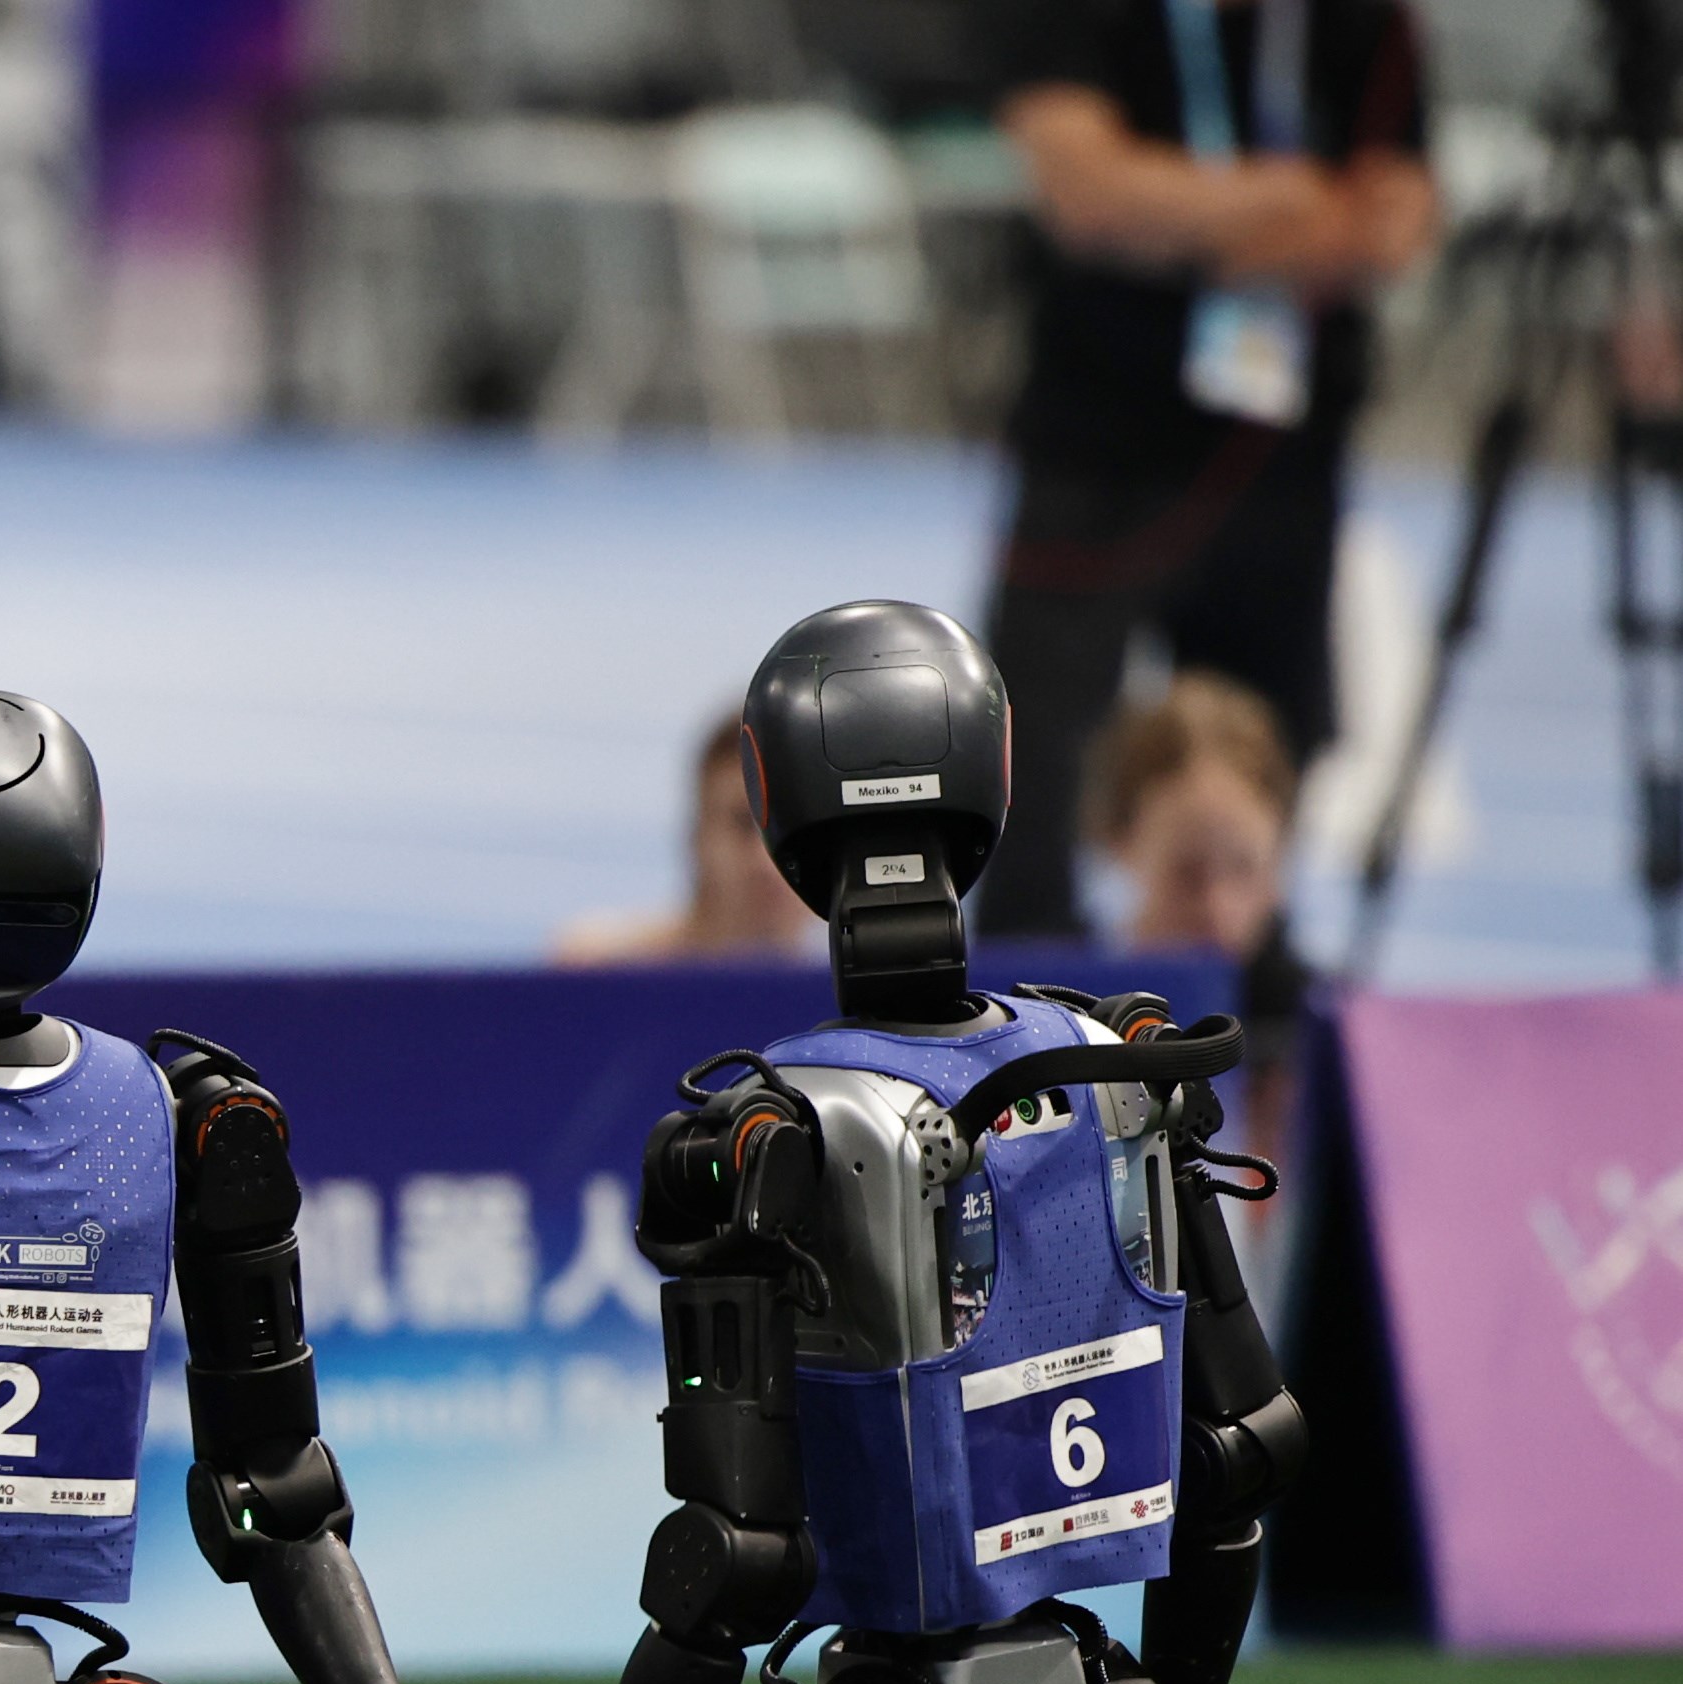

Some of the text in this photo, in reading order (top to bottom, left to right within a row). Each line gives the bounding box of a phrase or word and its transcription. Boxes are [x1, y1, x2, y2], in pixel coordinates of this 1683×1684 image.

[858, 783, 923, 797] Mexiko 94
[21, 1246, 84, 1265] ROBOTS
[6, 1322, 48, 1333] Humanoid
[50, 1325, 75, 1334] Robot
[76, 1326, 103, 1335] Games
[1049, 1397, 1105, 1488] 6
